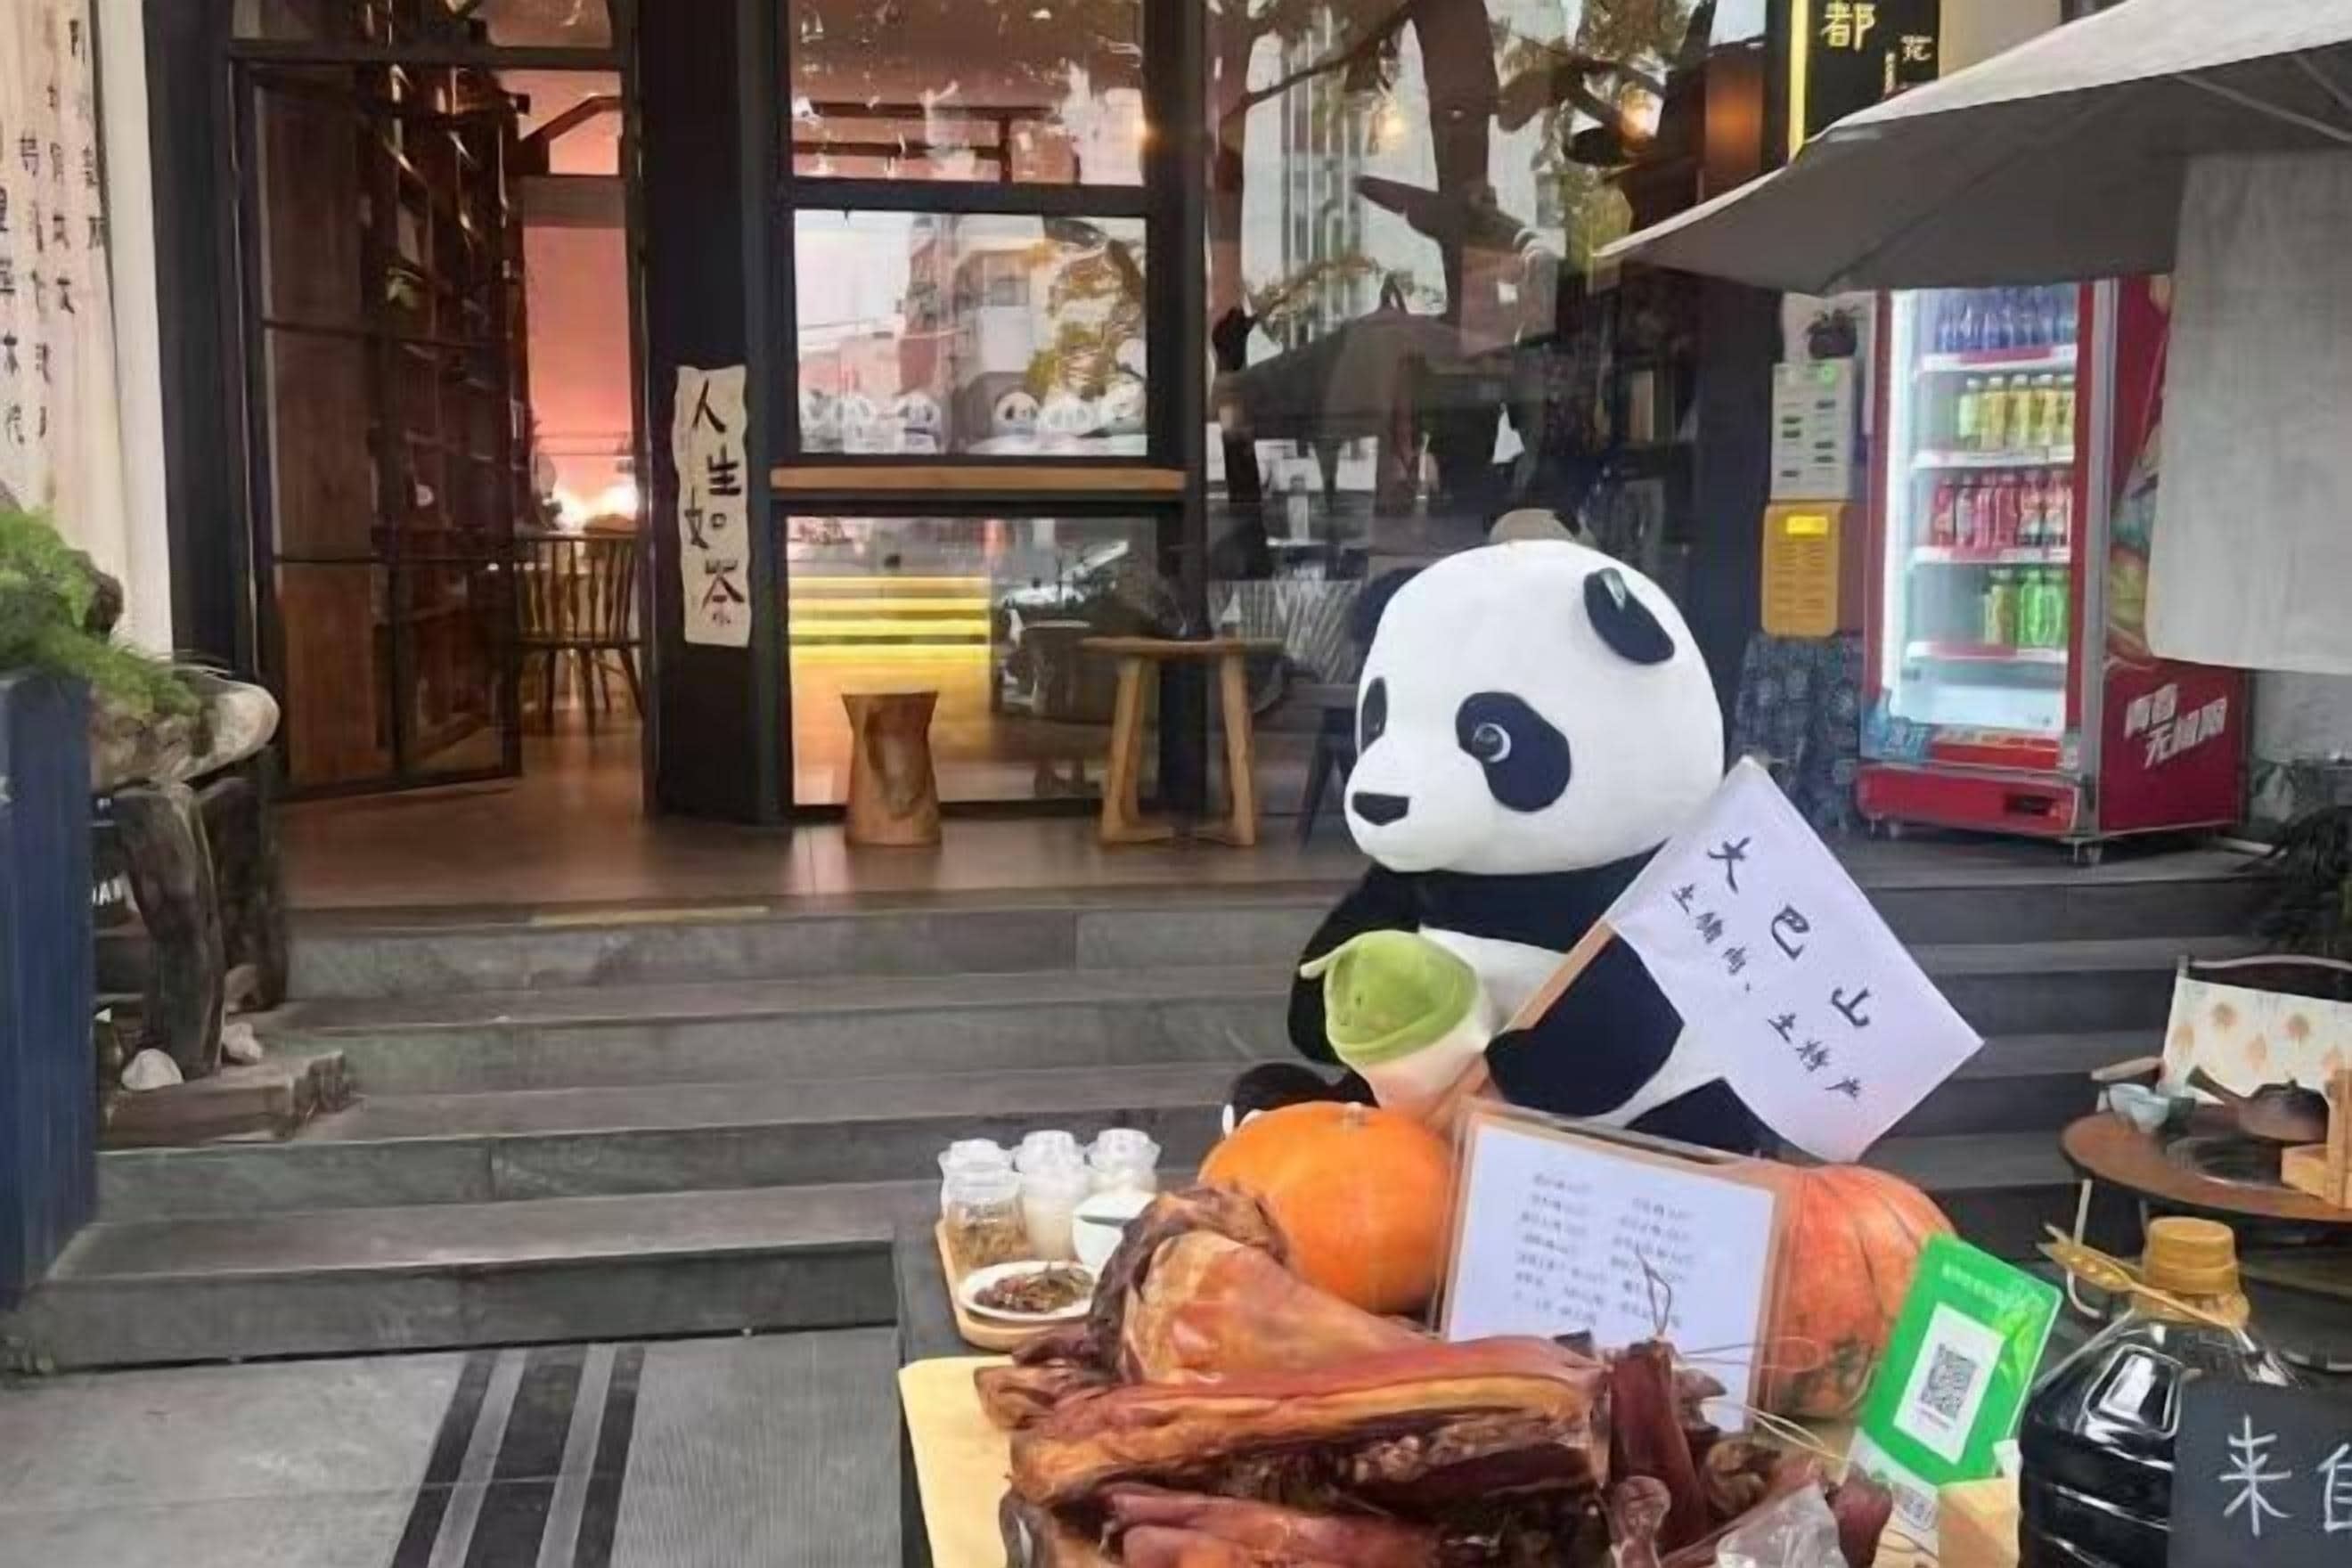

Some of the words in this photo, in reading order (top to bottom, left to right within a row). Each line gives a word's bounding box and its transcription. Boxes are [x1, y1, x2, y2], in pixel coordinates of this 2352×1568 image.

[1820, 2, 1876, 52] 都
[1708, 836, 1872, 1027] 大巴山
[2218, 1414, 2352, 1538] 来自
